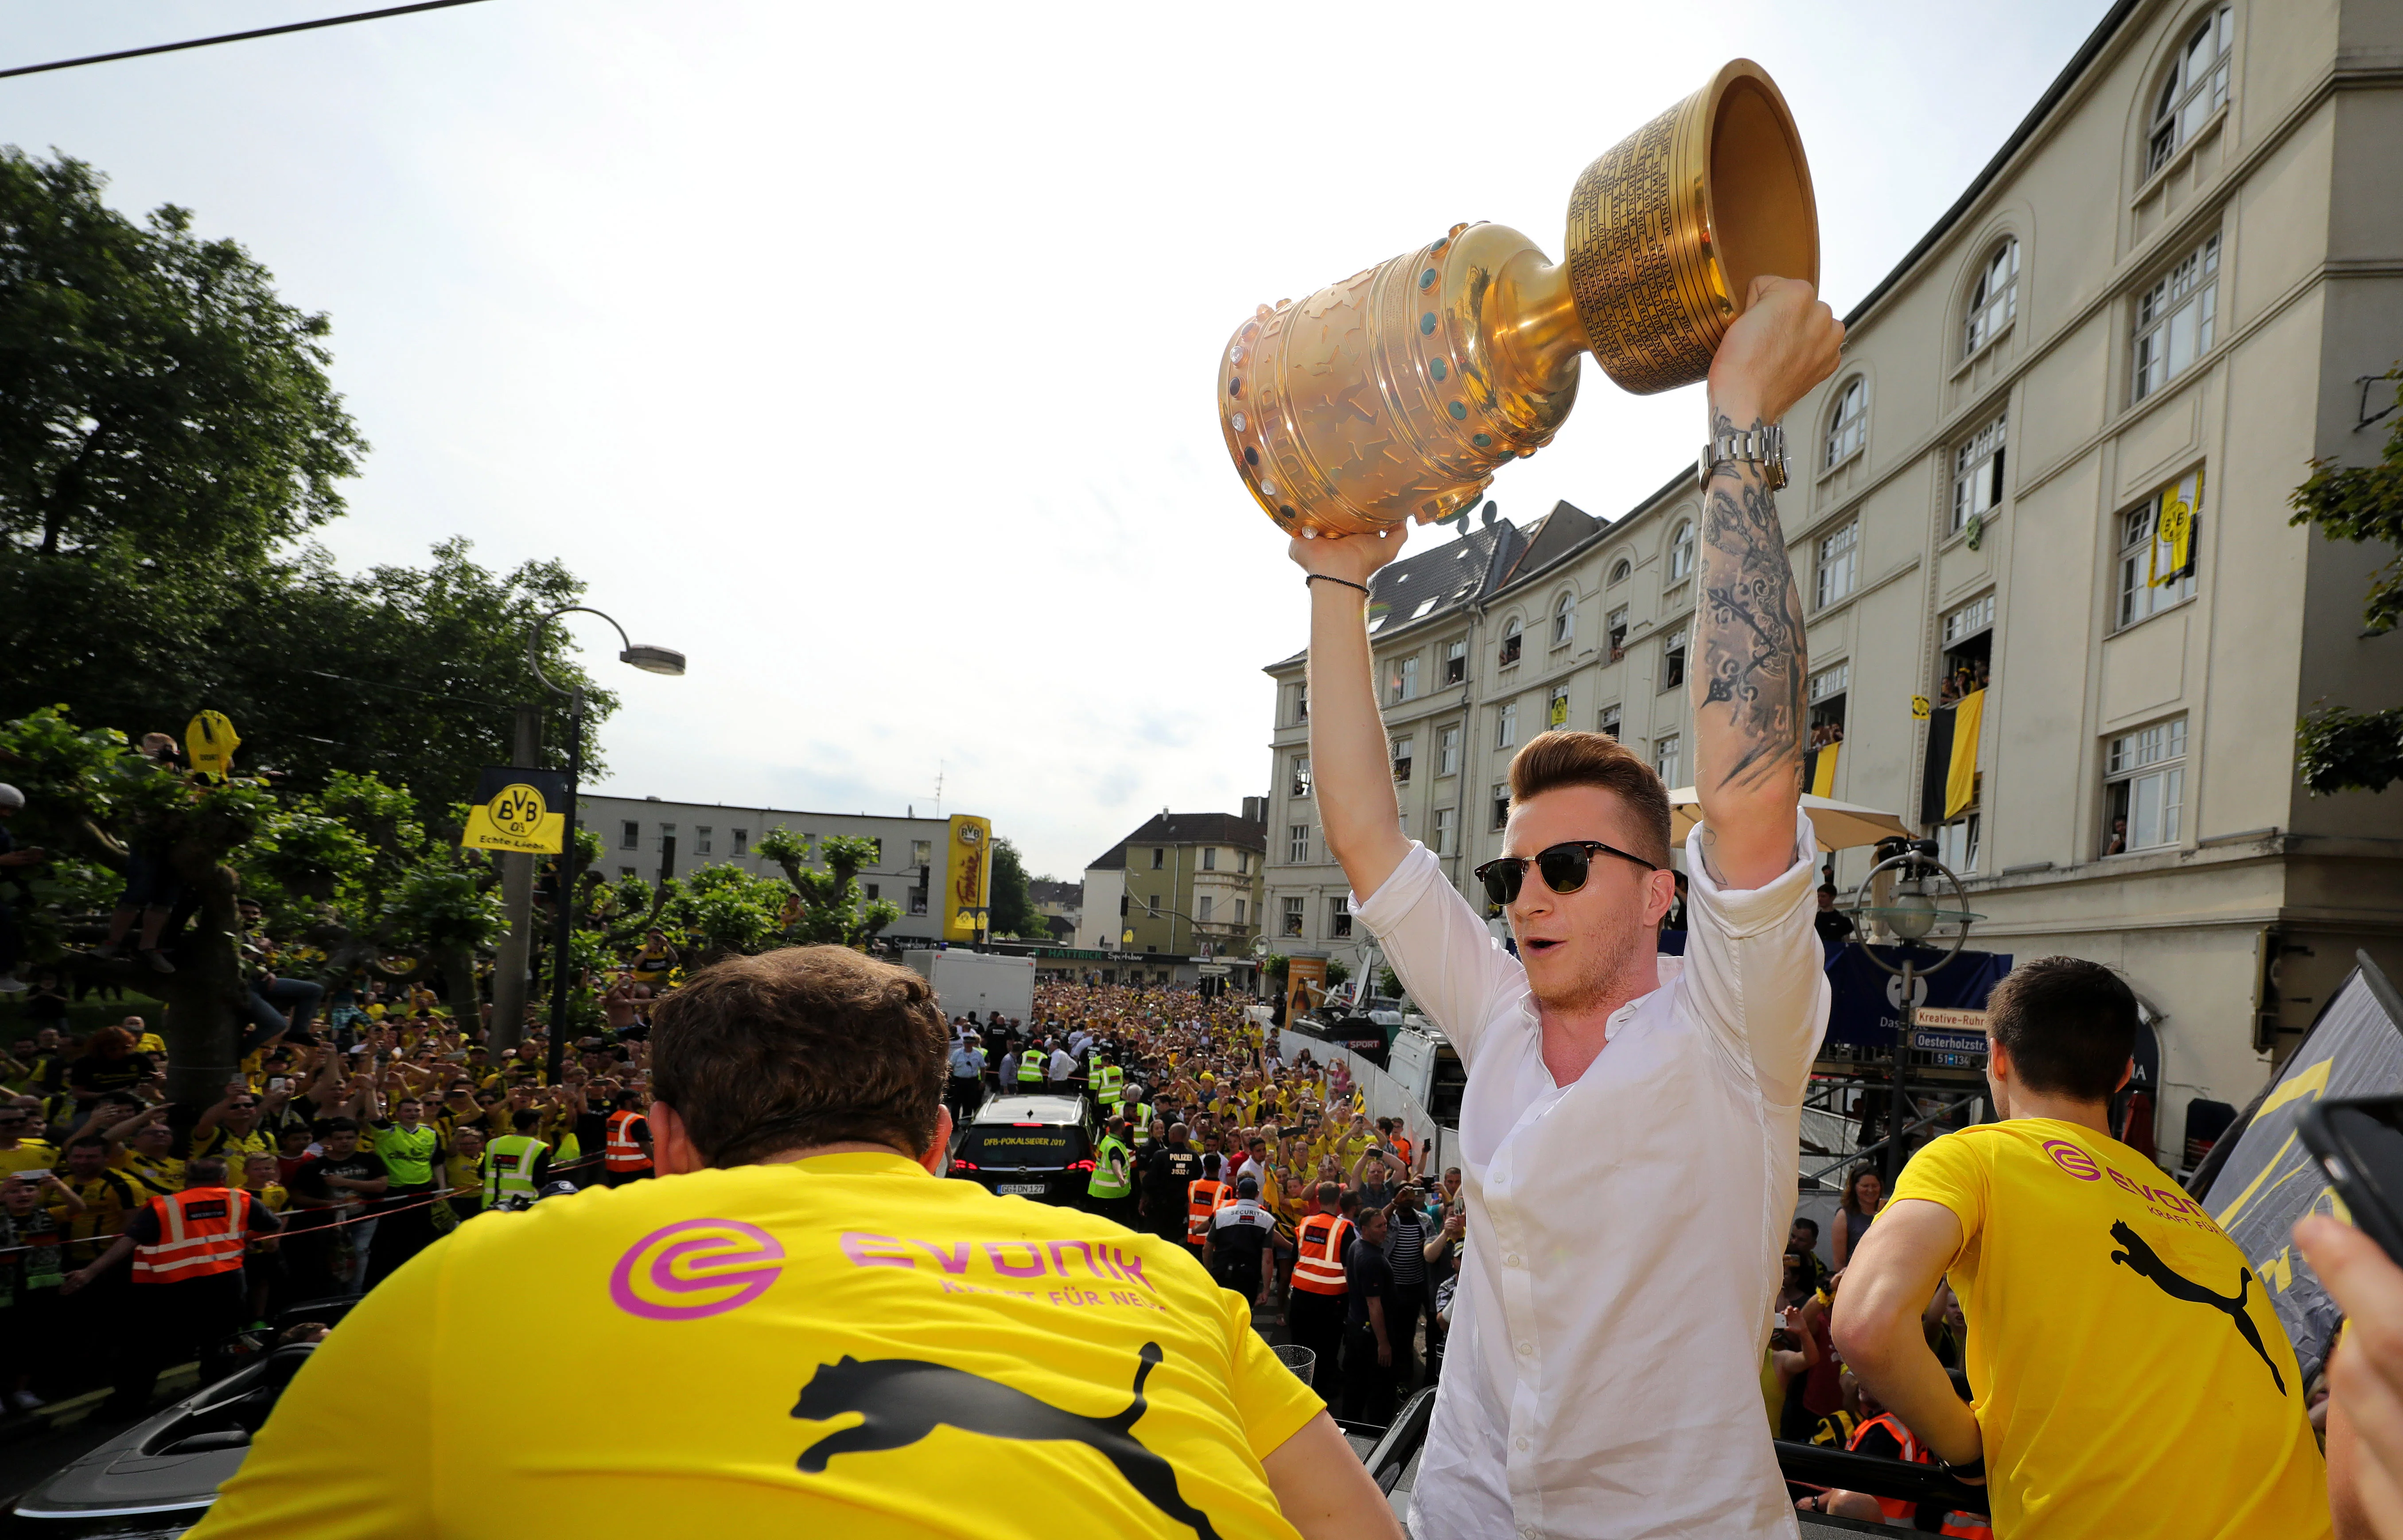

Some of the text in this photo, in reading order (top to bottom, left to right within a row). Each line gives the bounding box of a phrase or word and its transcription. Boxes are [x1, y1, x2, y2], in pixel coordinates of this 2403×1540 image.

[1662, 137, 1671, 157] 2015
[1614, 176, 1620, 189] 96
[1637, 154, 1645, 204] WERDER
[1644, 165, 1652, 181] FC
[1621, 189, 1627, 203] FC
[1628, 164, 1637, 228] MÜNCHEN
[1661, 172, 1672, 237] MÜNCHEN
[1606, 228, 1613, 242] SV
[1613, 195, 1624, 263] HANNOVER
[1602, 257, 1613, 288] KÖLN
[1631, 236, 1646, 287] BAYERN
[1648, 234, 1665, 292] WERDER
[1658, 243, 1676, 292] BAYERN
[1571, 248, 1586, 309] MÜNCHEN
[1579, 252, 1596, 314] MÜNCHEN
[1584, 240, 1604, 311] FRANKFURT
[1594, 250, 1610, 306] FORTUNA
[1621, 269, 1631, 293] 1992
[1643, 255, 1666, 316] MÜNCHEN
[1609, 248, 1634, 327] HAMBURGER
[1610, 296, 1619, 310] FC
[1644, 293, 1653, 308] FC
[1664, 299, 1677, 322] 2009
[1672, 297, 1681, 311] FC
[1608, 313, 1619, 334] 1979
[1652, 314, 1665, 335] 2000
[1680, 315, 1692, 334] 2014
[1585, 317, 1606, 355] BAYERN
[1596, 321, 1617, 359] BAYERN
[1601, 319, 1632, 371] EINTRACHT
[1622, 328, 1634, 346] 1983
[1633, 334, 1647, 352] 1987
[1636, 321, 1660, 358] BREMEN
[1664, 323, 1687, 356] BAYERN
[1605, 360, 1615, 369] FC
[1616, 362, 1625, 372] FC
[1628, 356, 1643, 372] 01/07
[498, 790, 537, 822] BVB
[1048, 948, 1102, 960] HATTRICK
[1880, 1017, 1900, 1029] Das
[1919, 1012, 1986, 1026] Kreative-Ruhr
[1918, 1035, 1986, 1051] Oesterholzstr.
[984, 1137, 1049, 1146] DFB-POKALSIEGER
[2106, 1166, 2205, 1217] EVON
[2146, 1205, 2192, 1226] KRAFT
[840, 1231, 1157, 1294] EVONIK
[1048, 1286, 1106, 1307] FÜR
